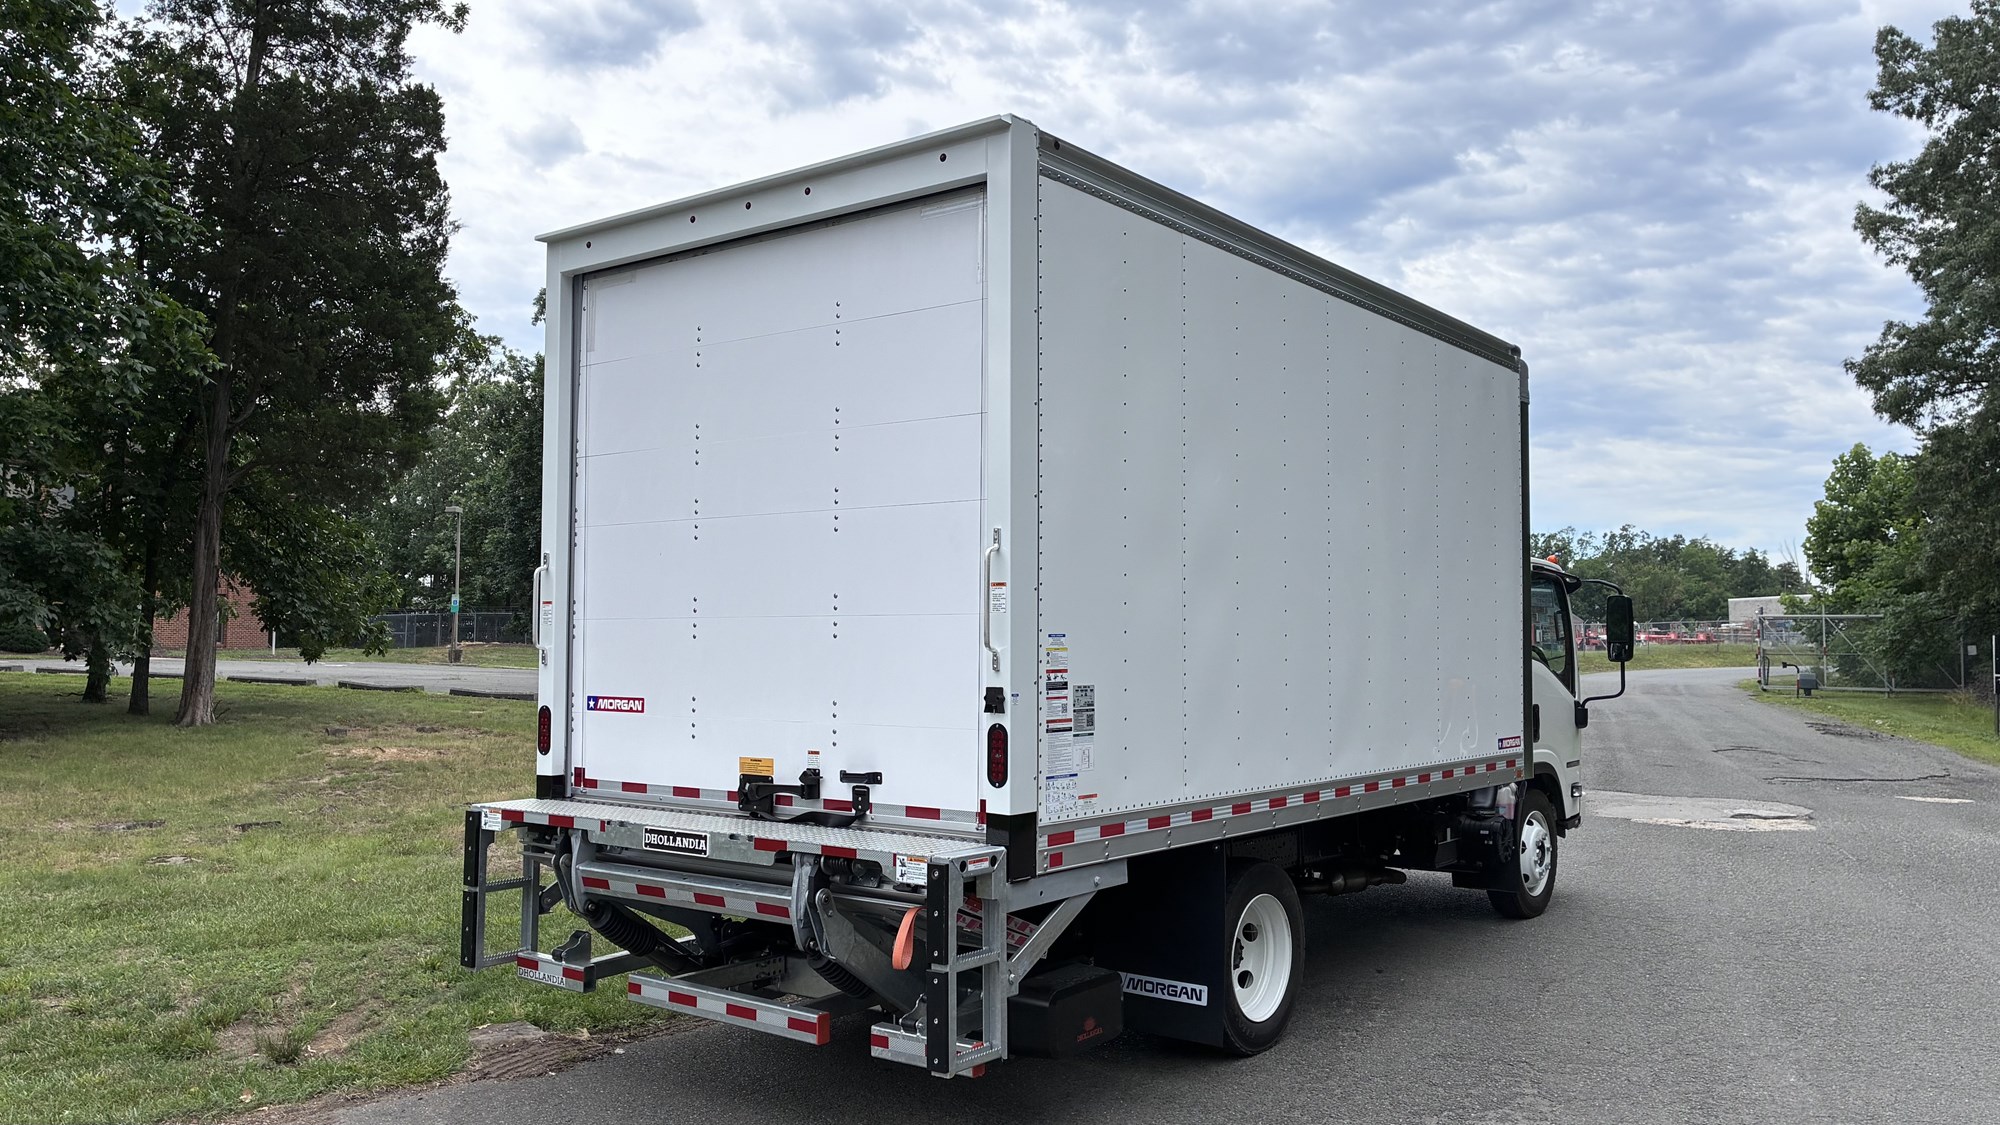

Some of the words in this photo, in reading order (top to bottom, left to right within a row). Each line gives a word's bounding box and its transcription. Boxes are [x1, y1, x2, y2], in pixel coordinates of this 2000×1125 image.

[597, 699, 643, 711] MORGAN
[645, 833, 706, 850] DHOLLANDIA
[518, 968, 564, 985] DHOLLANDIA
[1126, 977, 1203, 1001] MORGAN
